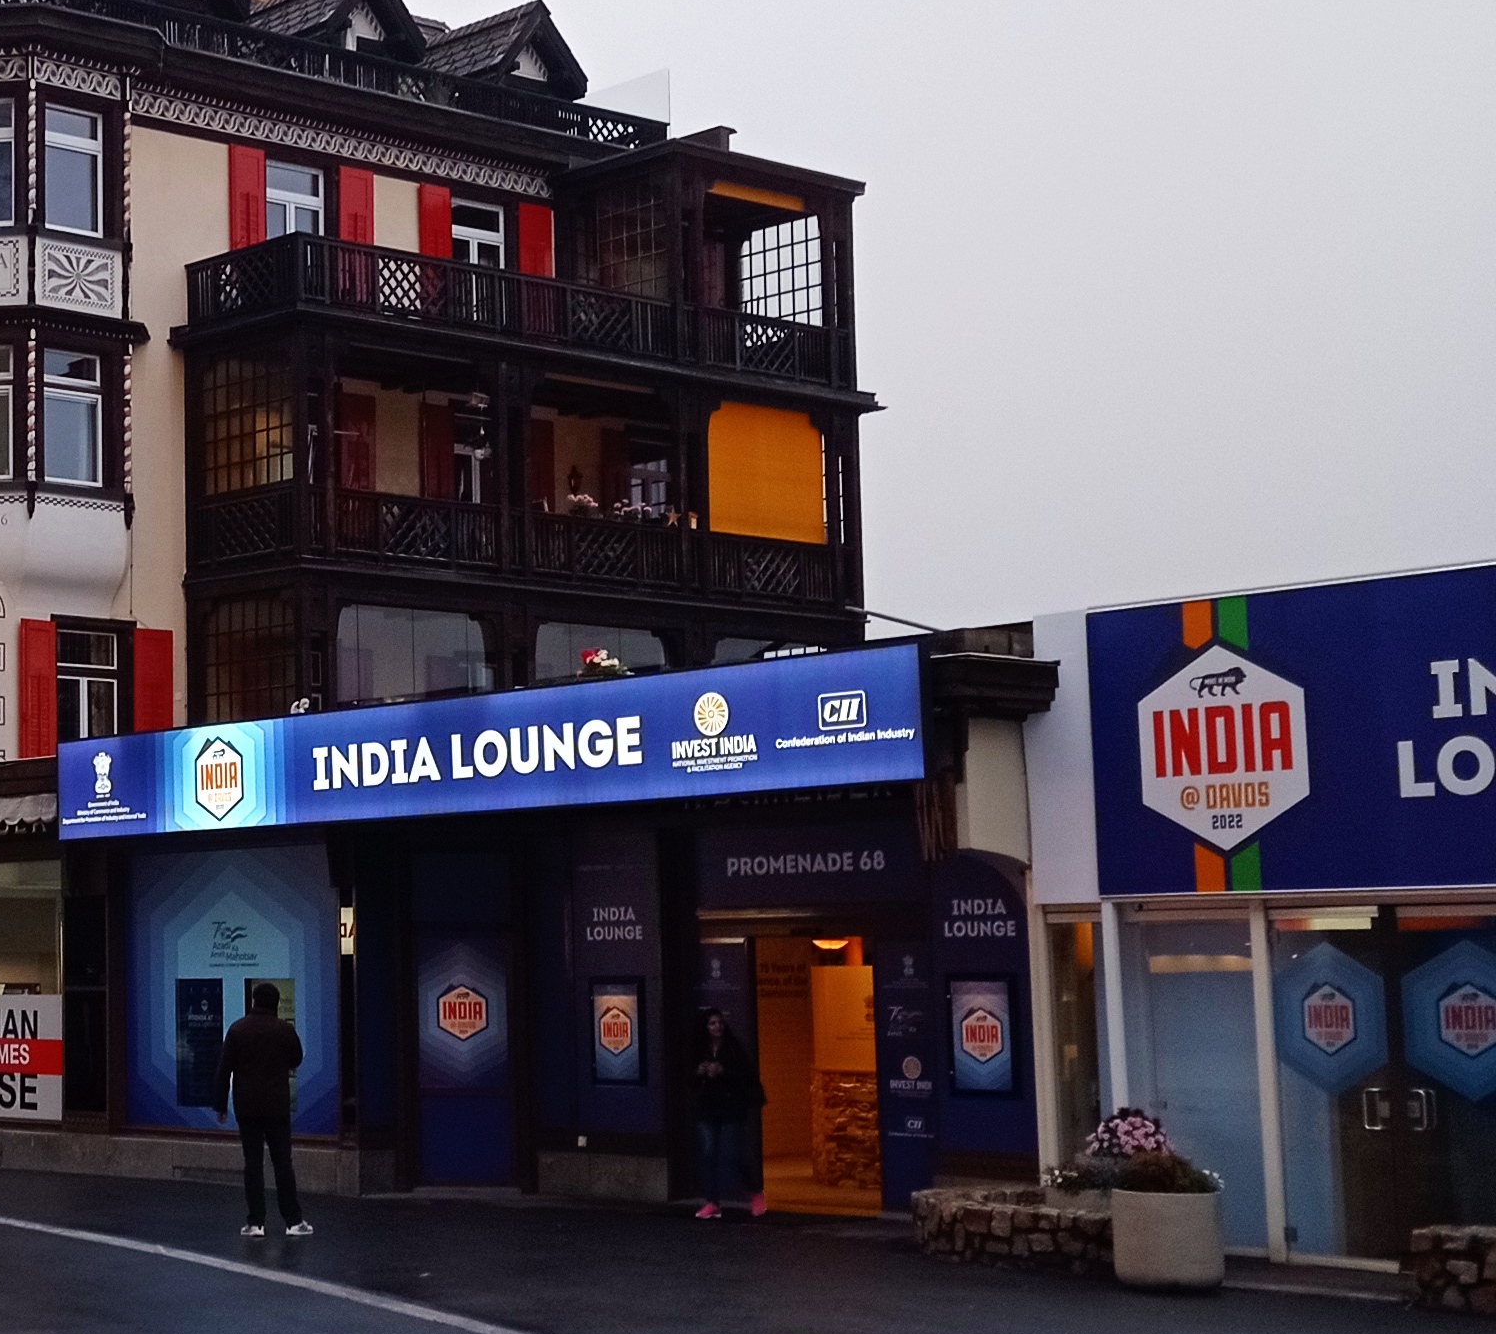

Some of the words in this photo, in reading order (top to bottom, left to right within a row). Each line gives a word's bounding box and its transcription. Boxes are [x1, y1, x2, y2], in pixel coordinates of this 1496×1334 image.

[823, 698, 861, 723] CII
[672, 738, 718, 759] INVEST
[720, 734, 757, 756] INDIA
[775, 735, 836, 750] Confederation
[837, 734, 847, 743] of
[847, 732, 876, 743] Indian
[876, 728, 915, 740] Industry
[1152, 700, 1293, 778] INDIA
[312, 736, 441, 791] INDIA
[451, 715, 643, 779] LOUNGE
[200, 761, 238, 790] INDIA
[1397, 735, 1496, 798] LO
[1180, 786, 1200, 810] @
[1205, 781, 1270, 810] DAVOS
[1212, 814, 1243, 830] 2022
[727, 851, 854, 877] PROMENADE
[859, 850, 886, 871] 68
[592, 906, 636, 922] INDIA
[951, 898, 1007, 916] INDIA
[586, 925, 643, 942] LOUNGE
[944, 920, 1016, 938] LOUNGE
[442, 1001, 483, 1020] INDIA
[1308, 1004, 1351, 1029] INDIA
[1445, 1004, 1496, 1030] INDIA
[602, 1021, 629, 1038] INDIA
[965, 1024, 999, 1044] INDIA
